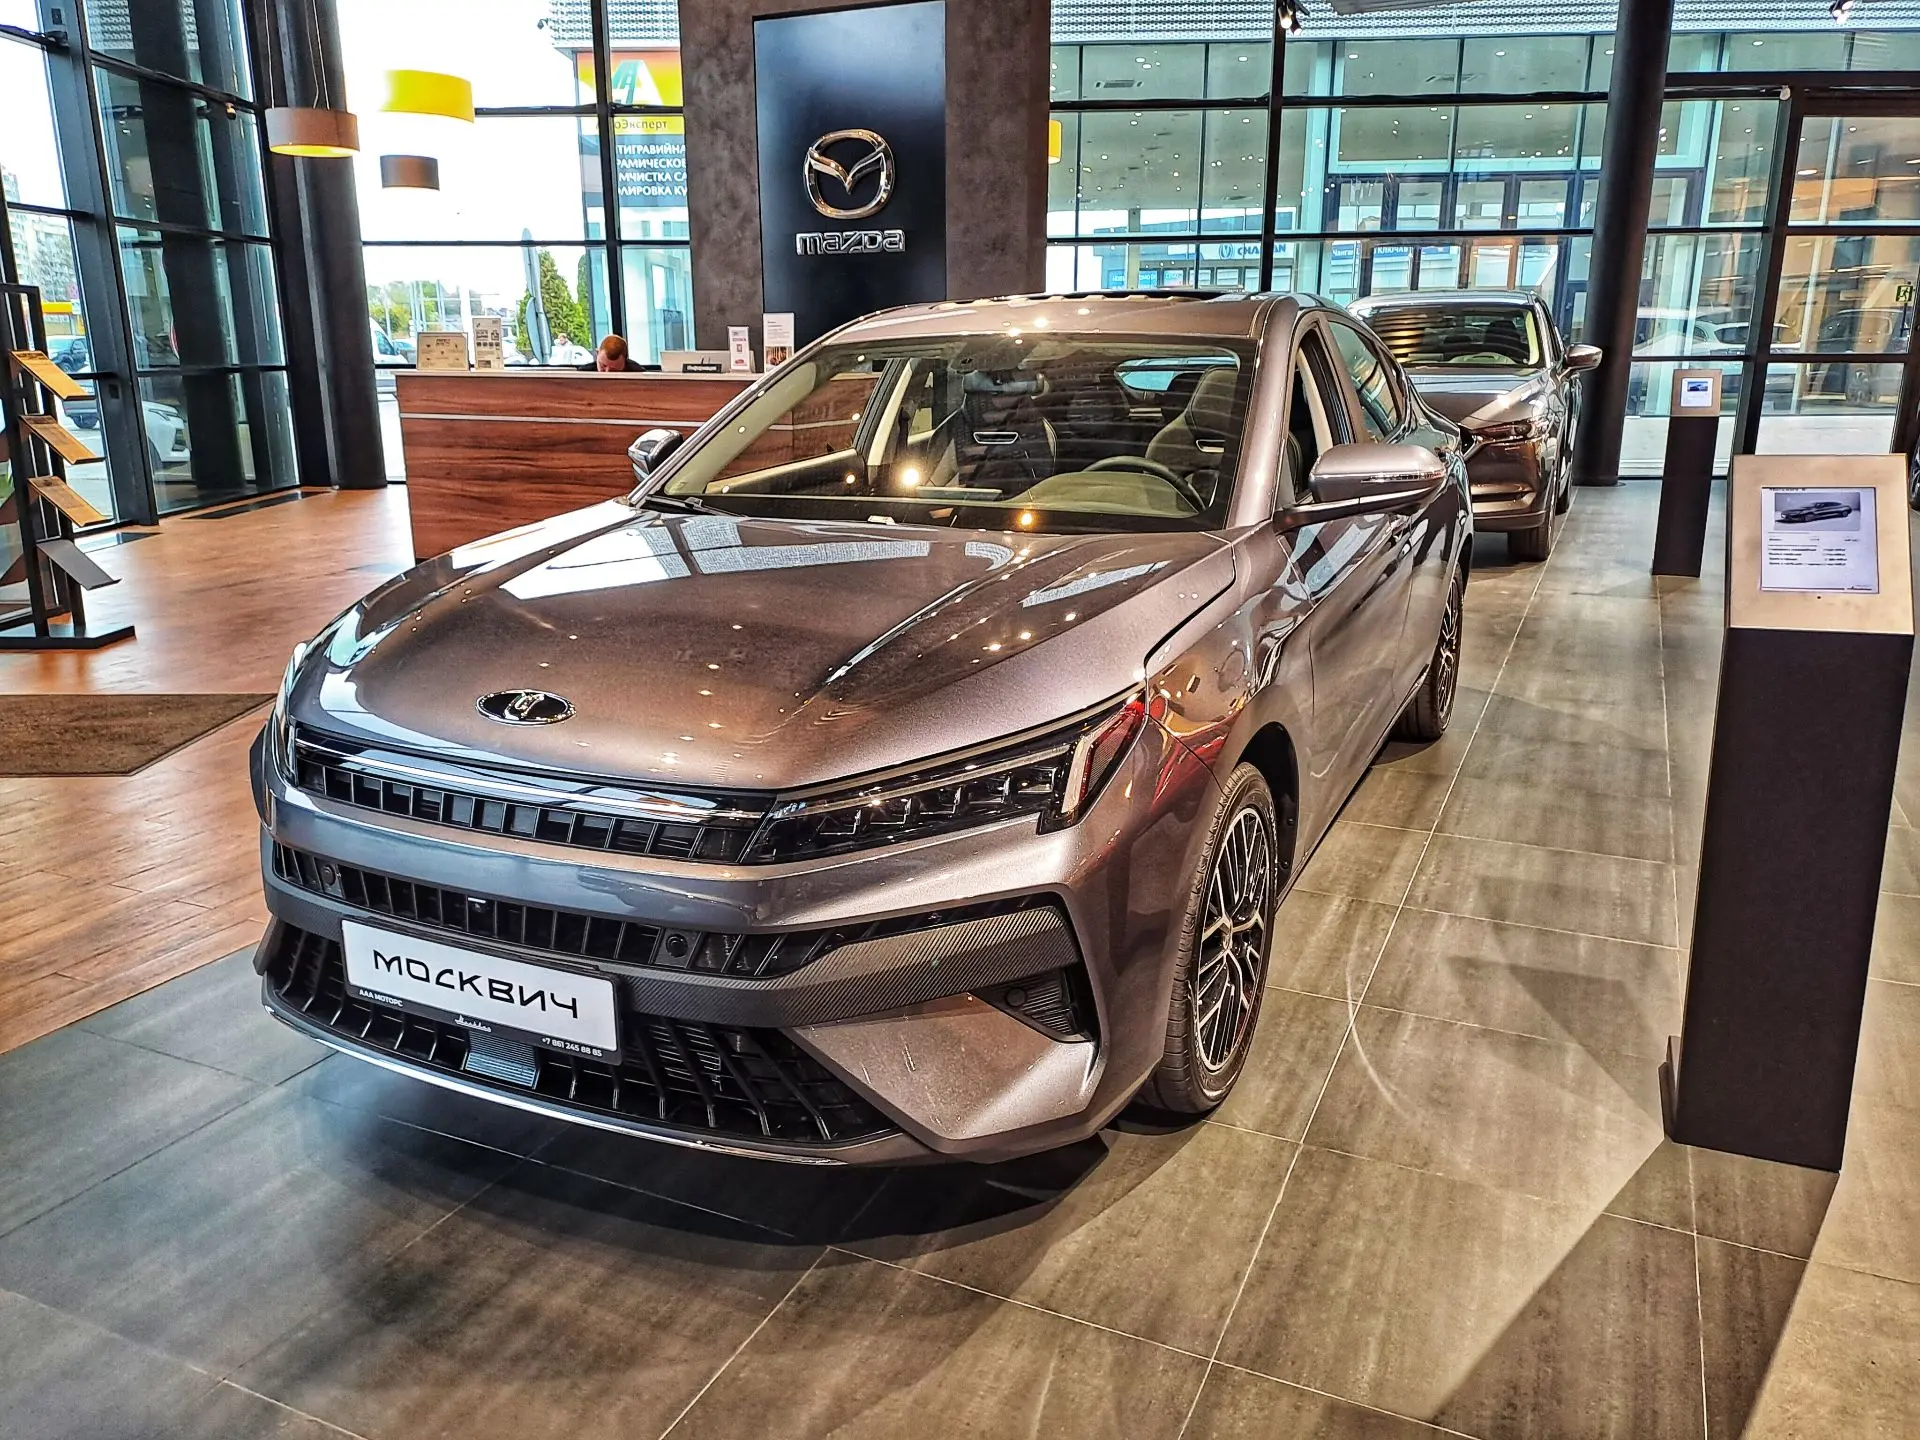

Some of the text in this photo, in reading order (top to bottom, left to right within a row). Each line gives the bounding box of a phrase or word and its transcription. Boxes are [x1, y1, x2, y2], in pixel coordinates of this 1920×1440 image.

[616, 143, 686, 155] ТИГРАВИЙНА
[372, 949, 579, 1019] МОСКВИЧ
[374, 993, 404, 1008] МОТОРС
[565, 1042, 580, 1052] 245
